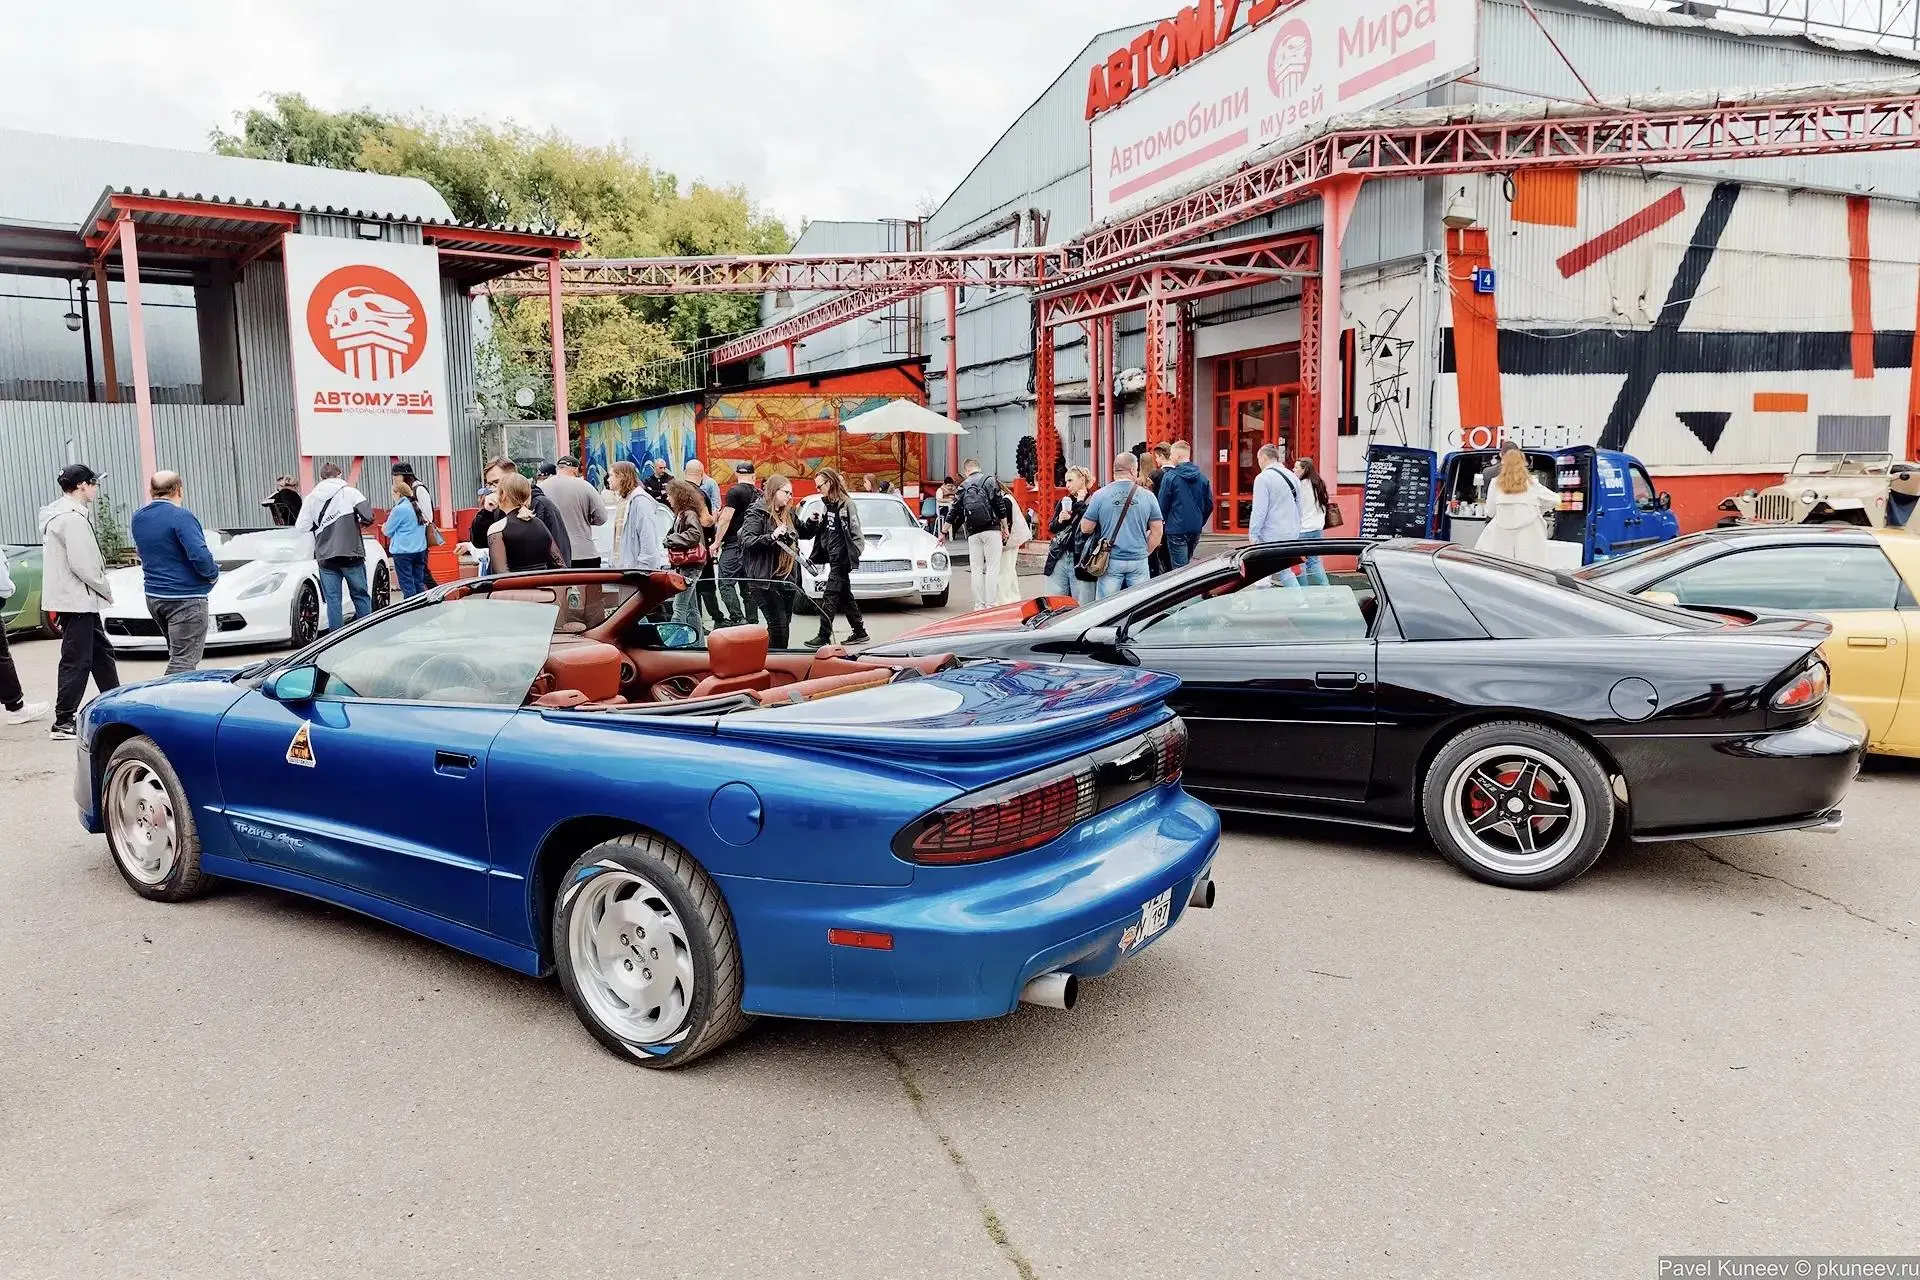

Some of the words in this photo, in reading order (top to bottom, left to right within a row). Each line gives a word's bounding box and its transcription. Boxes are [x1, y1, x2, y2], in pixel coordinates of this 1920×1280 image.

[1338, 0, 1436, 67] Мира
[1110, 87, 1249, 178] Автомобили
[1260, 85, 1324, 137] музей
[1484, 273, 1491, 286] 4
[313, 390, 433, 407] АВТОМУЗЕЙ
[1078, 794, 1157, 841] PONTIAC
[1152, 903, 1169, 925] 197
